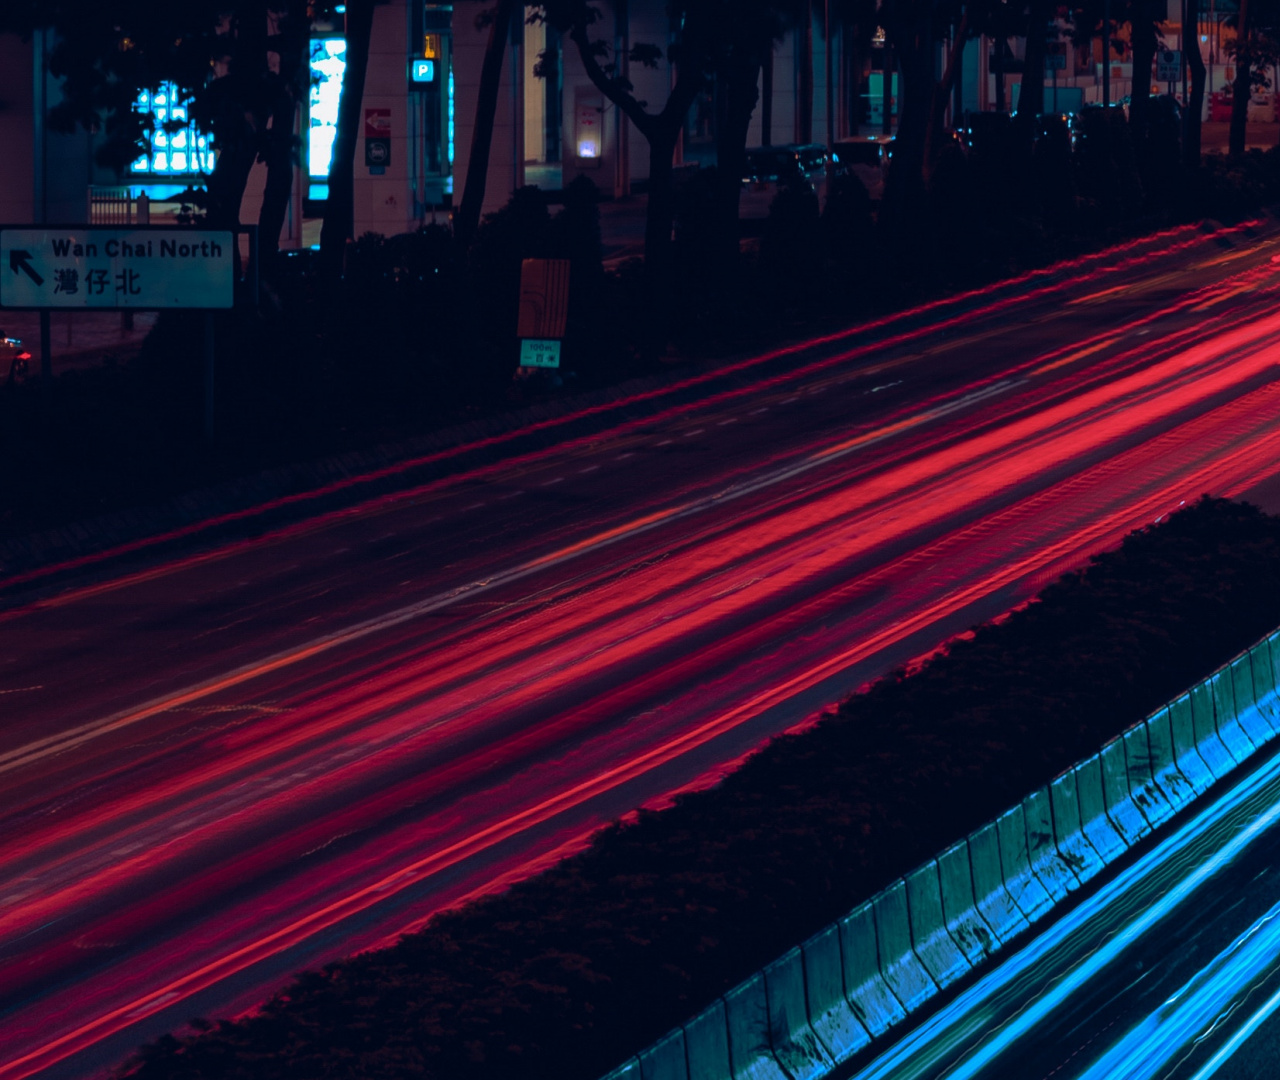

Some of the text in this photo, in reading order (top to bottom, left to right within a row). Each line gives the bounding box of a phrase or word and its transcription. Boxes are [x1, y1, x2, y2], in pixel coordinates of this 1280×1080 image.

[418, 64, 428, 77] P
[52, 238, 222, 258] Wan Chai North
[53, 268, 141, 295] 灣仔北
